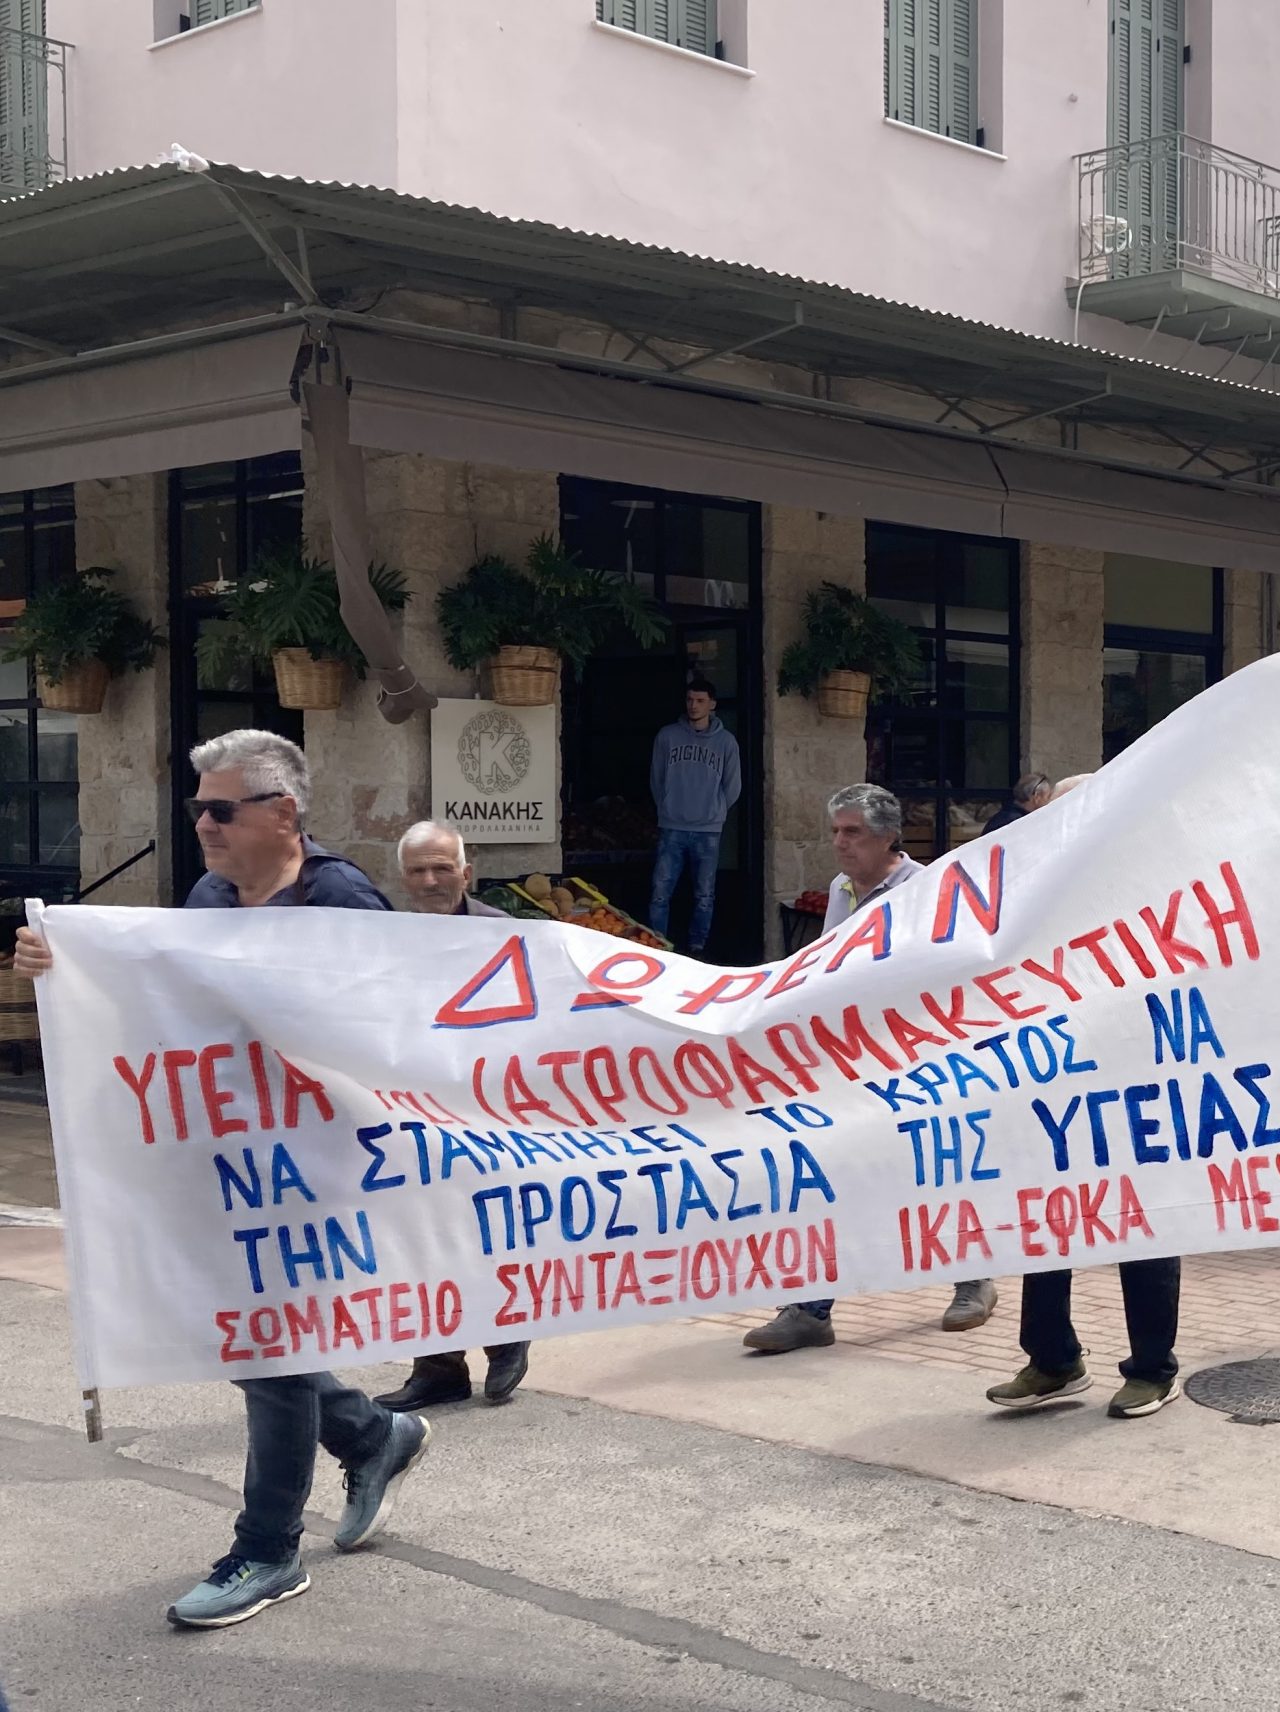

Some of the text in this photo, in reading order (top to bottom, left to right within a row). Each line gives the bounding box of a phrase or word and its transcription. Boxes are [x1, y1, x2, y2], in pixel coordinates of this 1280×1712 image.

[445, 801, 543, 820] ΚΑΝΑΚΗΣ
[456, 824, 541, 832] ΠΩΡΟΛΑΧΑΝΙΚΑ
[114, 1041, 334, 1144] ΥΓΕΙΑ
[473, 861, 1259, 1126] ΙΑΤΡΟΦΑΡΜΑΚΕΥΤΙΚΗ
[433, 844, 1004, 1029] ΔΩΡΕΑΝ
[213, 1142, 317, 1211] ΝΑ
[357, 1121, 705, 1191] ΣΤΑΜΑΤΗΣΕΙ
[746, 1102, 833, 1134] ΤΟ
[865, 1014, 1097, 1113] ΚΡΑΤΟΣ
[1145, 986, 1225, 1064] ΝΑ
[216, 1279, 462, 1362] ΣΩΜΑΤΕΙΟ
[495, 1218, 839, 1327] ΣΥΝΤΑΞΙΟΥΧΩΝ
[898, 1175, 1154, 1272] ΙΚΑ-ΕΦΚΑ
[233, 1210, 377, 1293] ΤΗΝ
[472, 1140, 836, 1255] ΠΡΟΣΤΑΣΙΑ
[897, 1109, 1000, 1186] ΤΗΣ
